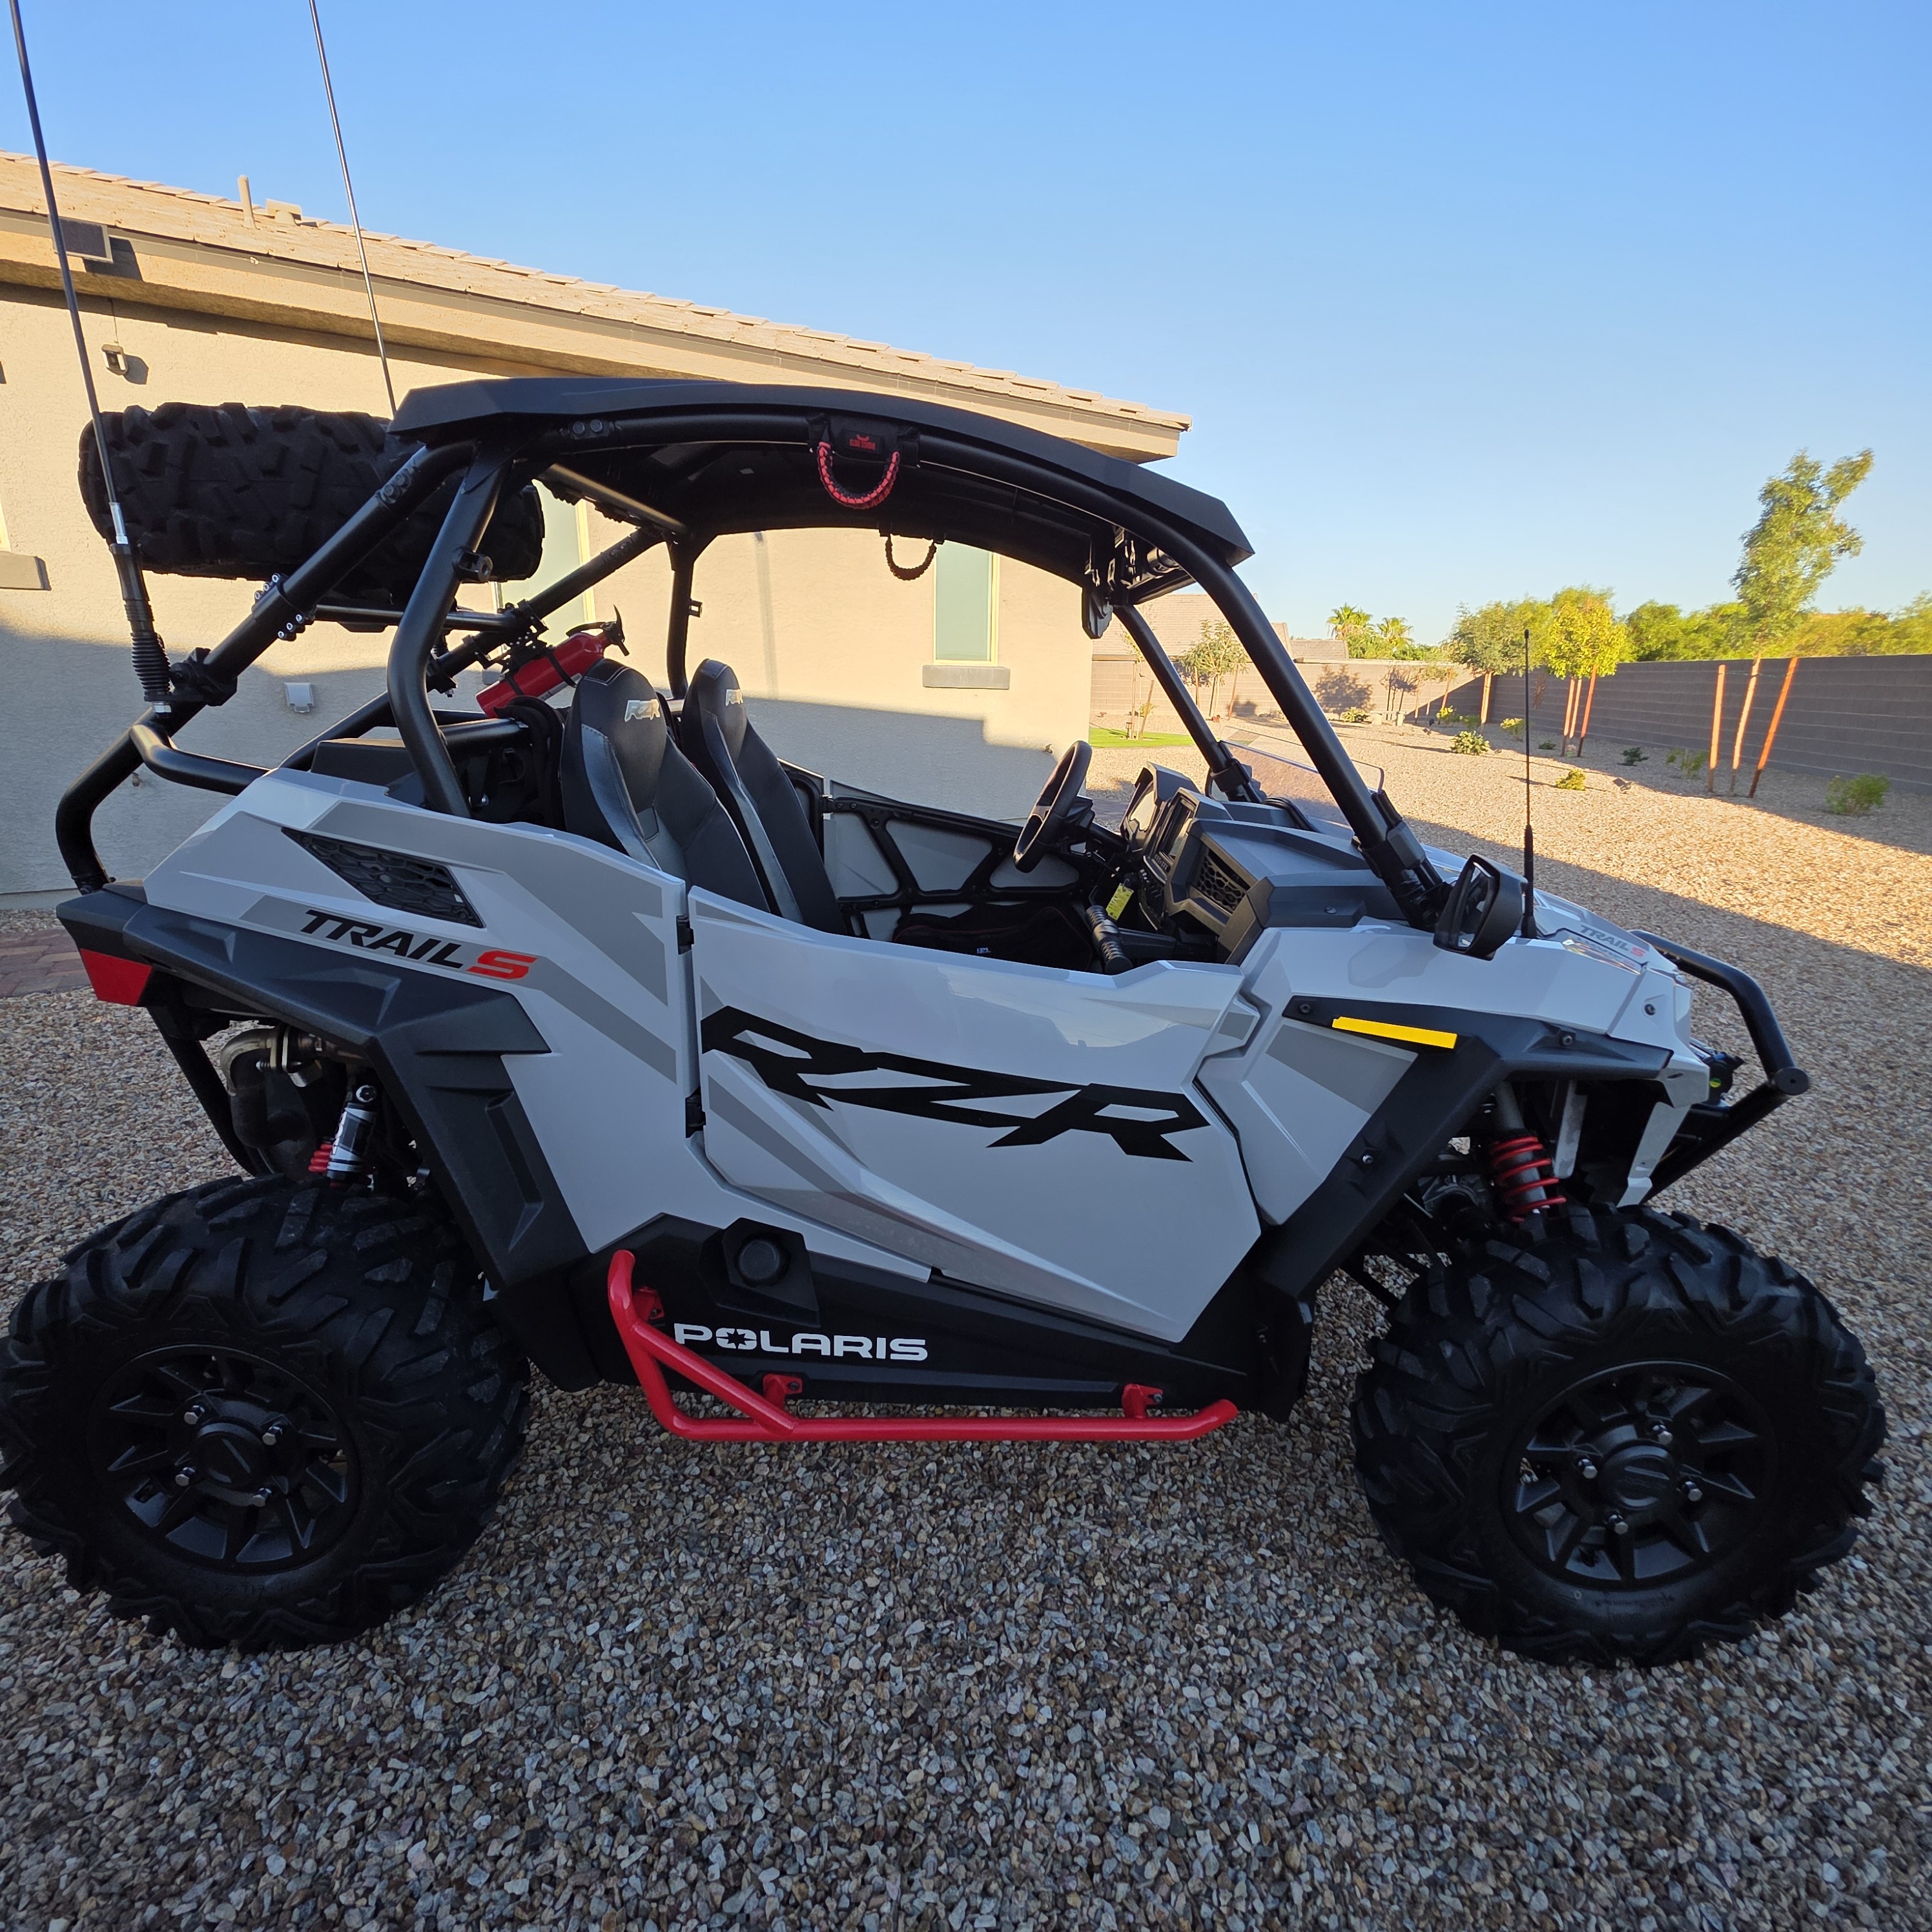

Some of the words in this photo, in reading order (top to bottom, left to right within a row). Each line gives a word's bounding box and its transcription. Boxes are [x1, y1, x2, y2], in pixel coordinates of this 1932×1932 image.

[624, 699, 660, 722] RZR
[300, 909, 464, 969] TRAIL
[466, 950, 539, 980] S
[1581, 925, 1629, 951] TRAIL
[1630, 947, 1646, 958] S
[701, 1005, 1211, 1162] RZR
[673, 1323, 928, 1361] POLARIS
